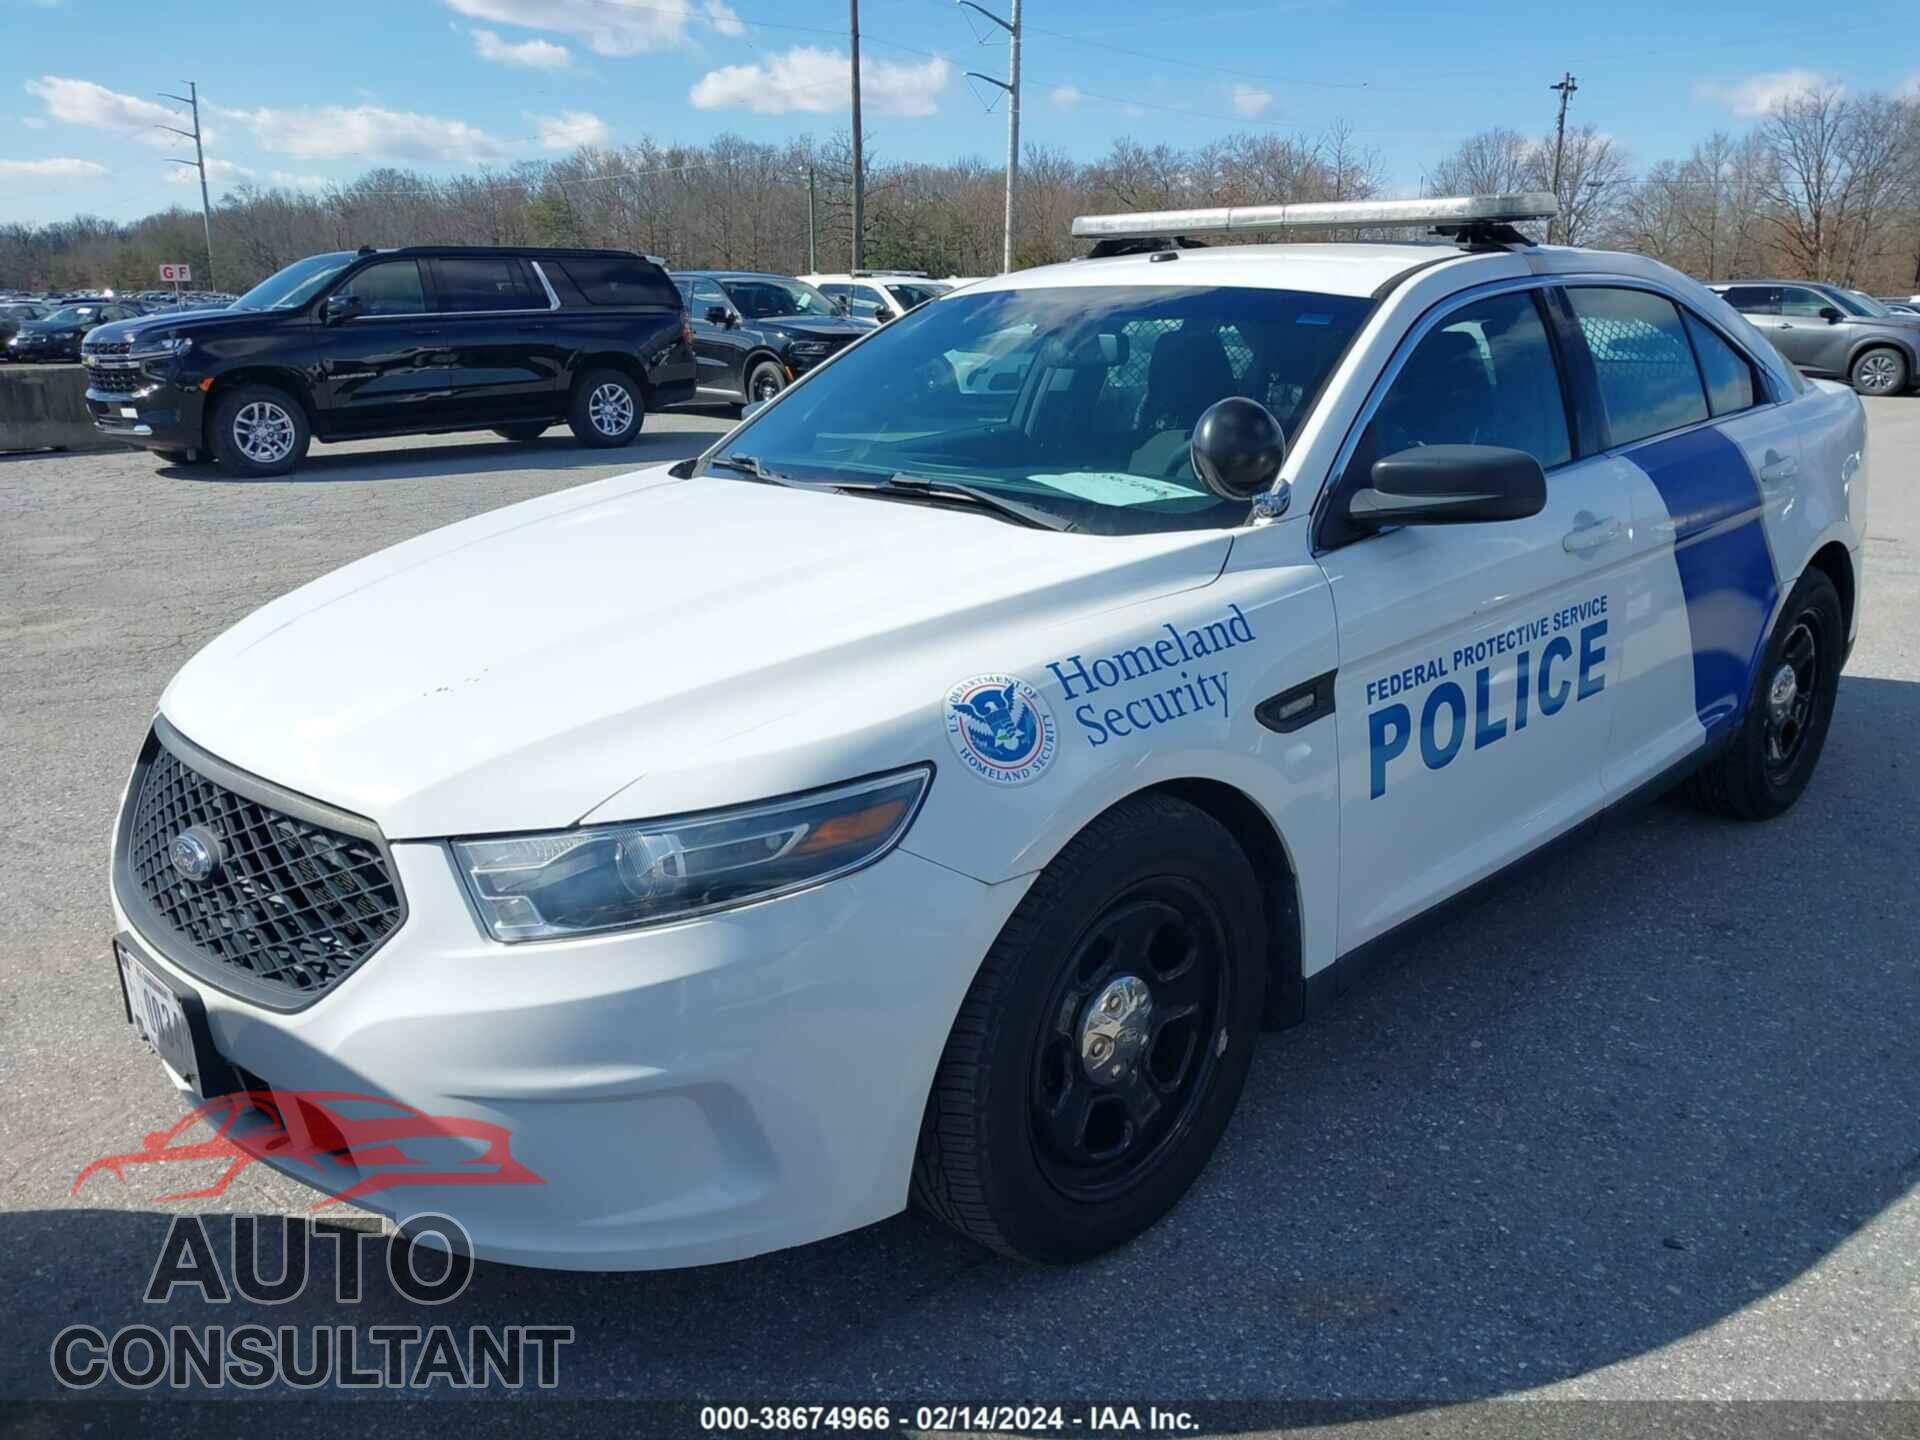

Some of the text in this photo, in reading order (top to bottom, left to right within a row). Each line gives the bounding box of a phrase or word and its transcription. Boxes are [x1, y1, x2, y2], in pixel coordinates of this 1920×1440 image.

[1045, 604, 1256, 700] Homeland
[1366, 595, 1608, 705] FEDERAL PROTECTIVE SERVICE
[959, 713, 1055, 782] HOMELAND SECURITY
[1075, 671, 1228, 747] Security
[1368, 619, 1608, 800] POLICE
